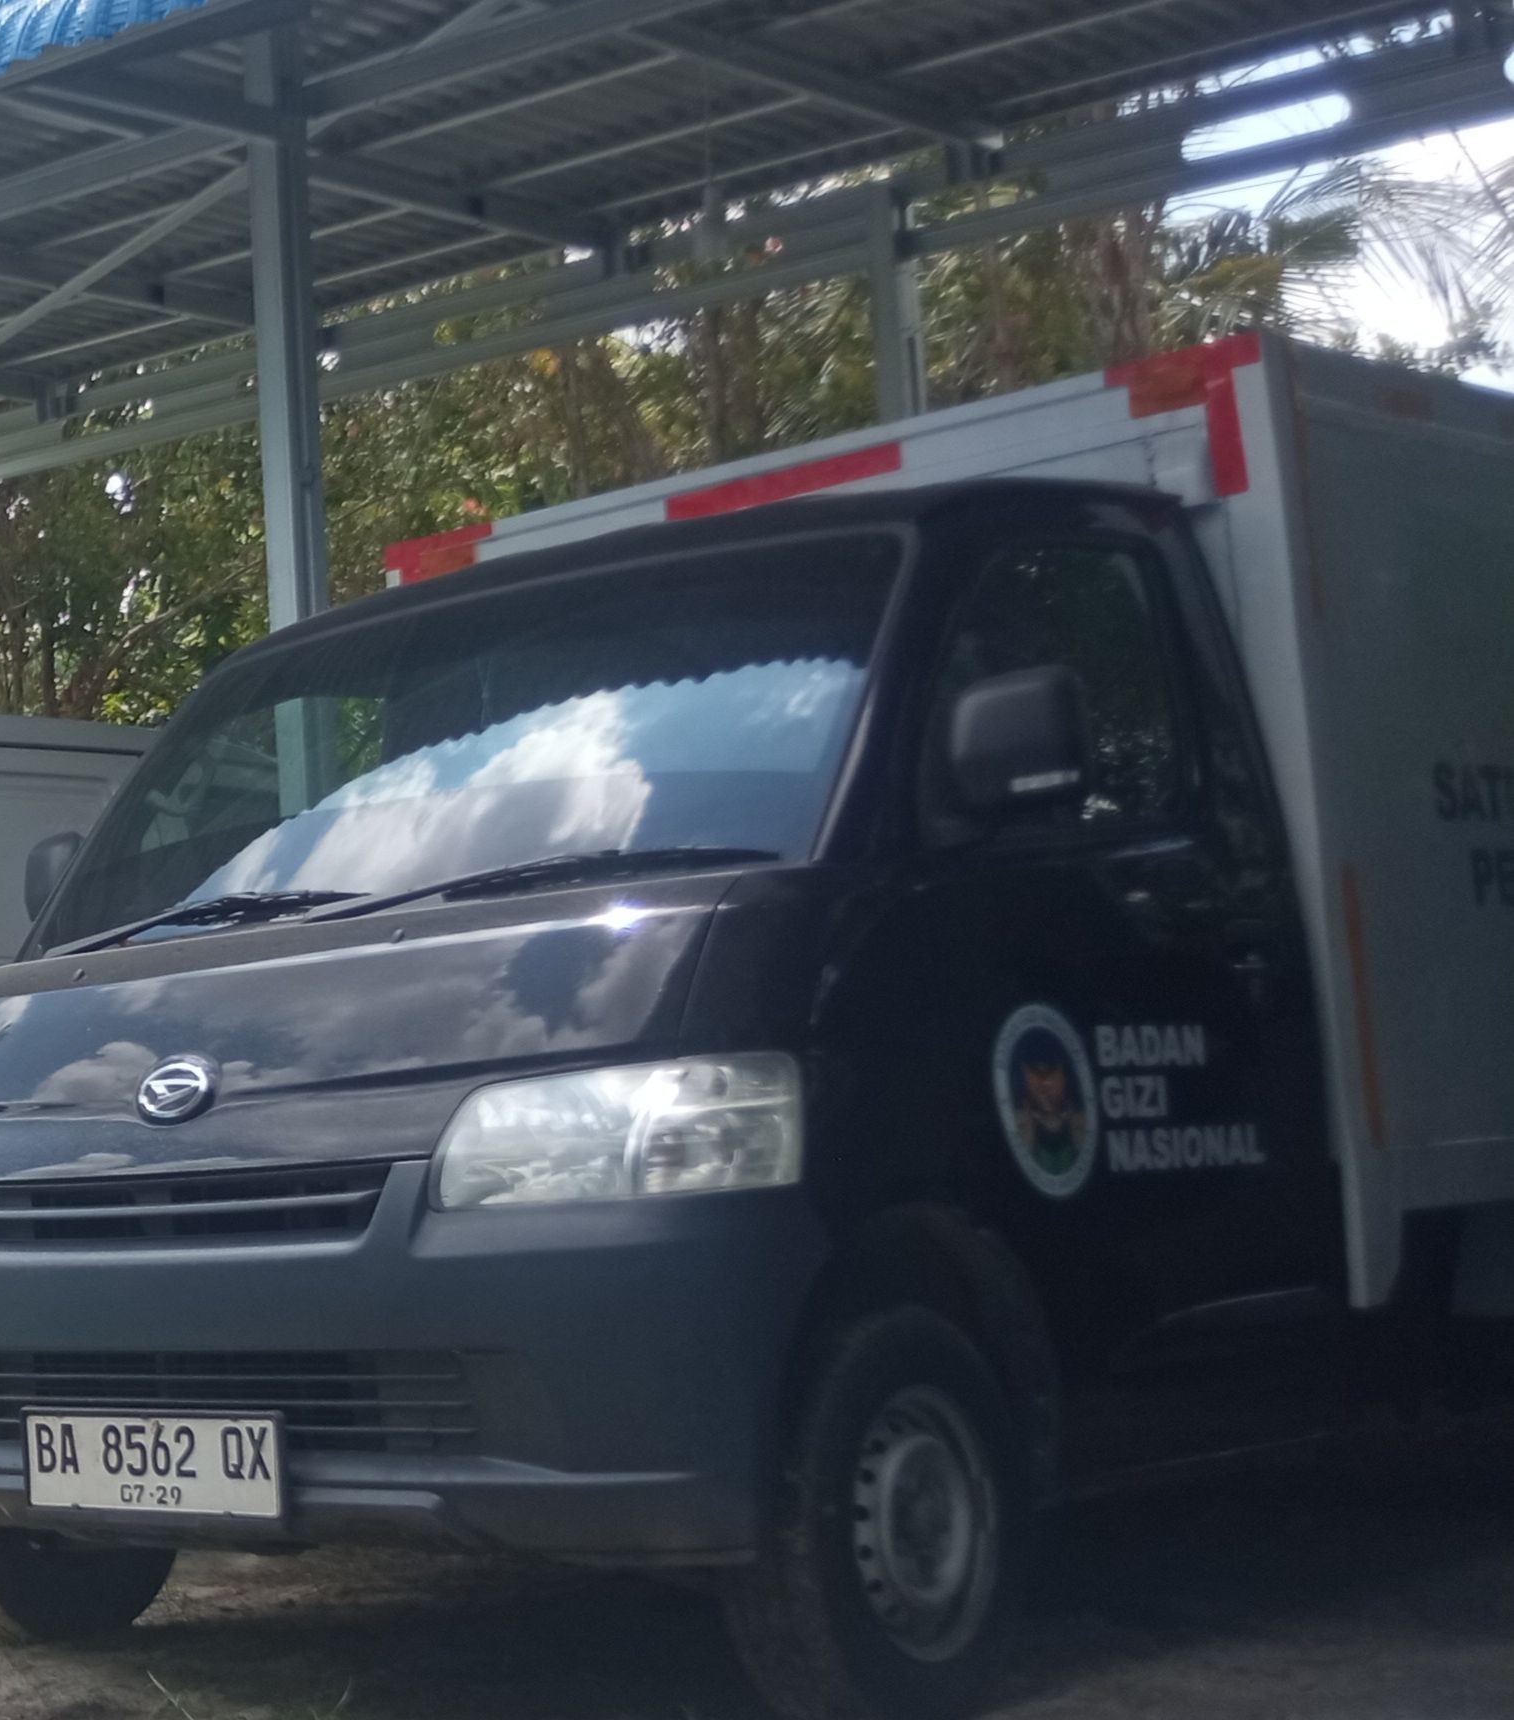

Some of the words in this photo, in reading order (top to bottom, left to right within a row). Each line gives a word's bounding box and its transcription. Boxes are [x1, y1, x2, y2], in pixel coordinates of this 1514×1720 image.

[1094, 1024, 1206, 1067] BADAN
[1100, 1075, 1168, 1119] GIZI
[1106, 1123, 1267, 1172] NASIONAL
[35, 1422, 80, 1475] BA
[102, 1424, 197, 1478] 8562
[221, 1426, 271, 1480] QX
